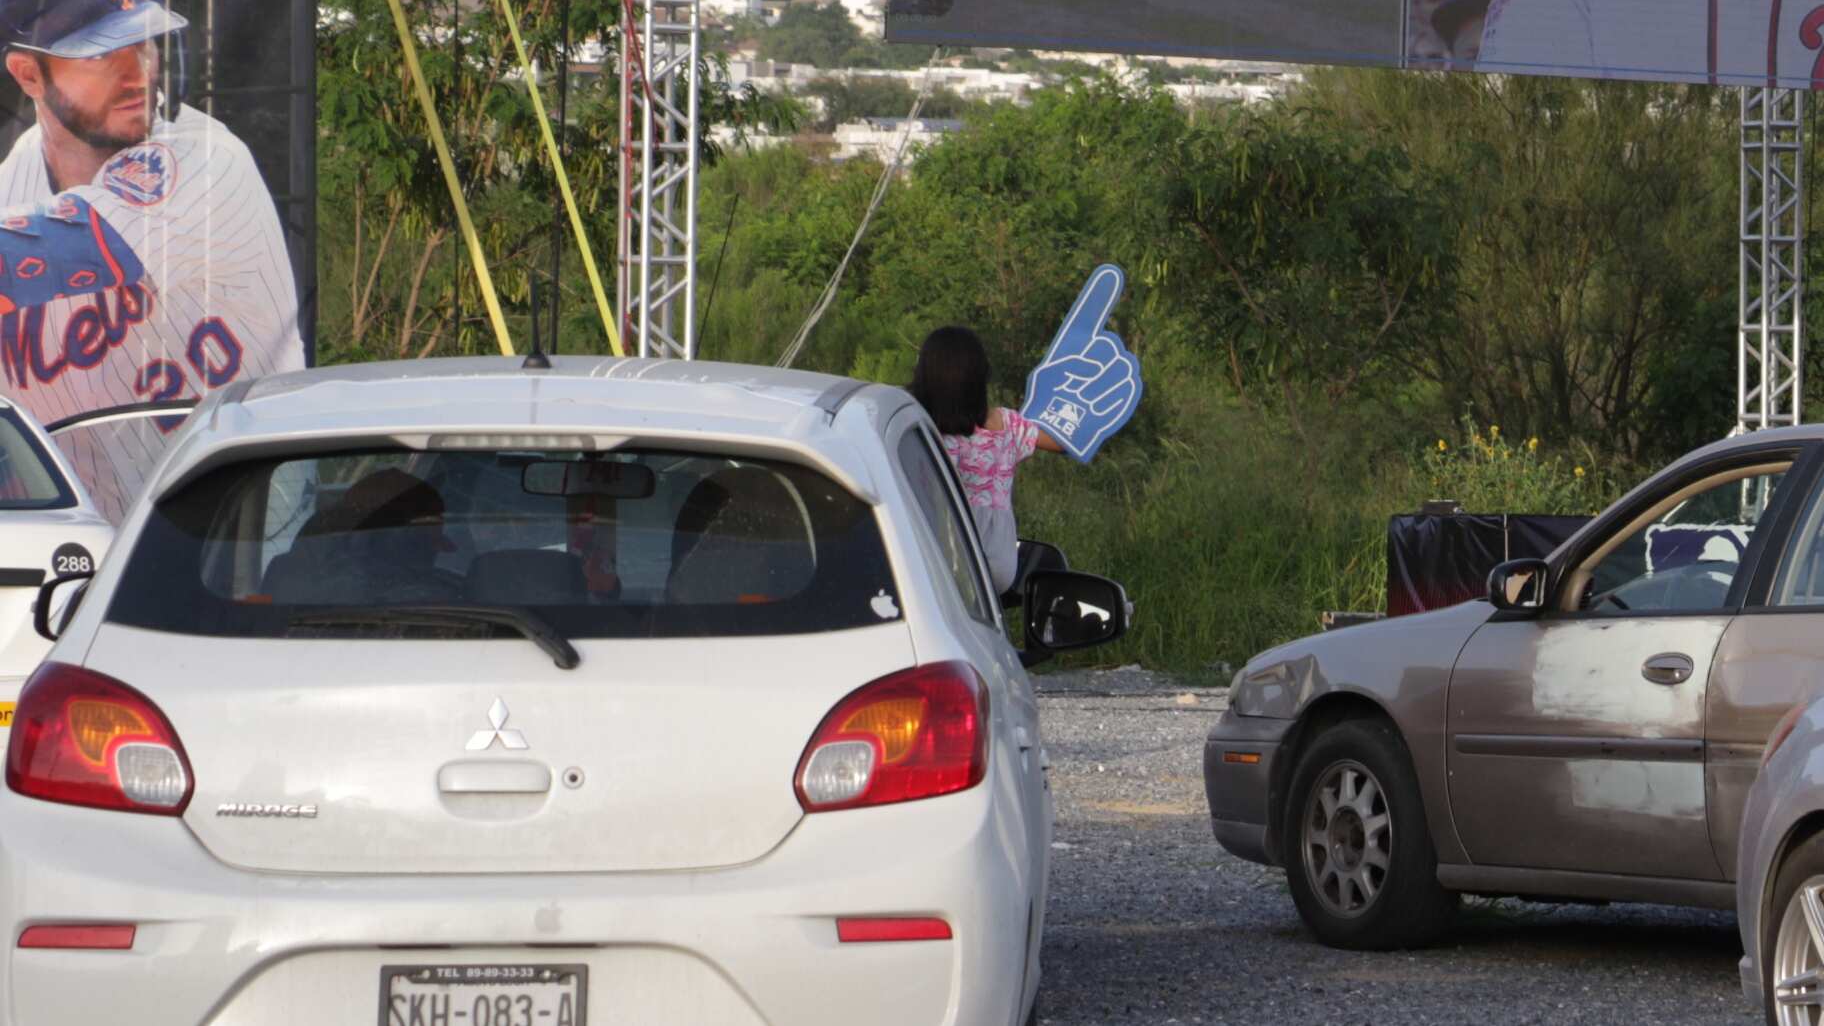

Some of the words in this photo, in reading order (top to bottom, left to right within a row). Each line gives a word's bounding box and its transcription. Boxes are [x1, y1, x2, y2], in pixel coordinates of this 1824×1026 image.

[1039, 411, 1076, 436] MLB
[56, 555, 91, 573] 288
[216, 803, 318, 819] MIRAGE
[436, 968, 460, 978] TEL
[466, 967, 534, 978] 89-89-33-33
[389, 992, 574, 1026] SKH-083-A
